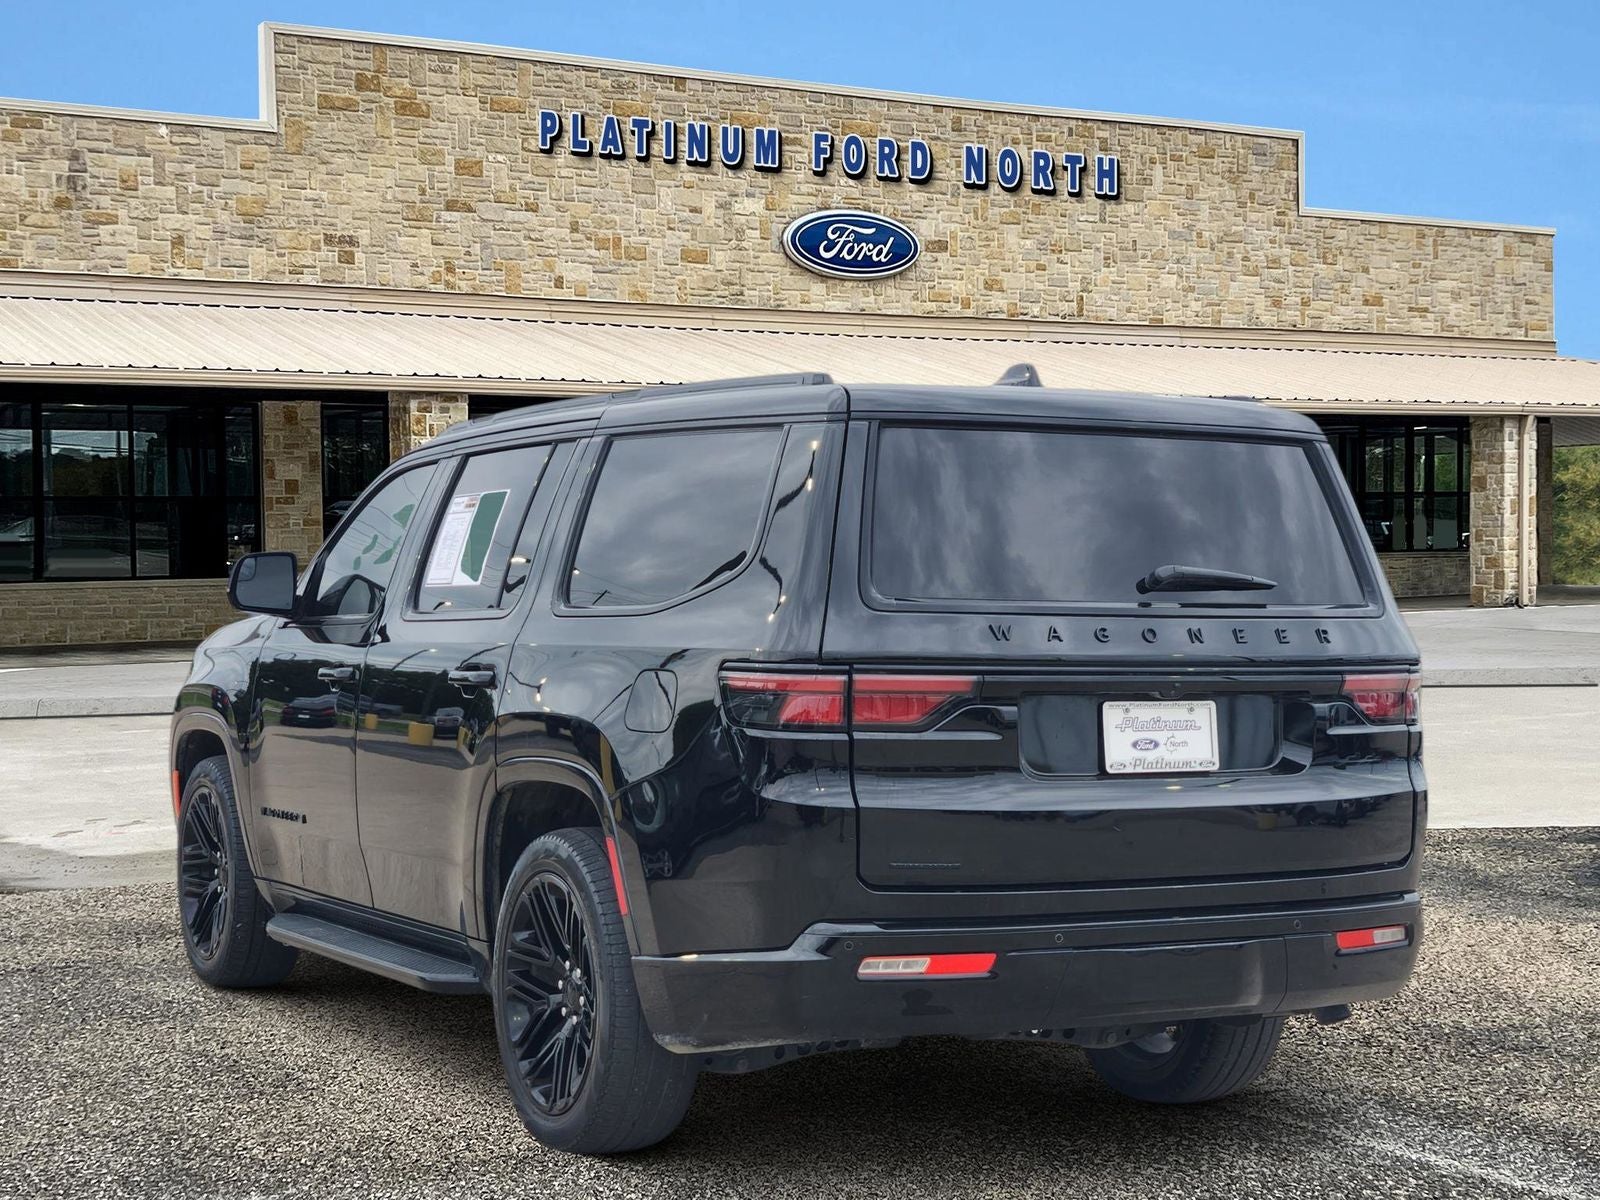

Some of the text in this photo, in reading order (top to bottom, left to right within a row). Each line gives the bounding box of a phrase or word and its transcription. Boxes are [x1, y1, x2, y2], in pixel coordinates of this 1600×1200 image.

[538, 109, 1121, 200] PLATINUM FORD NORTH
[819, 223, 894, 262] Ford
[988, 623, 1333, 645] WAGONEER
[1115, 716, 1202, 732] Platinum
[1169, 739, 1188, 748] North
